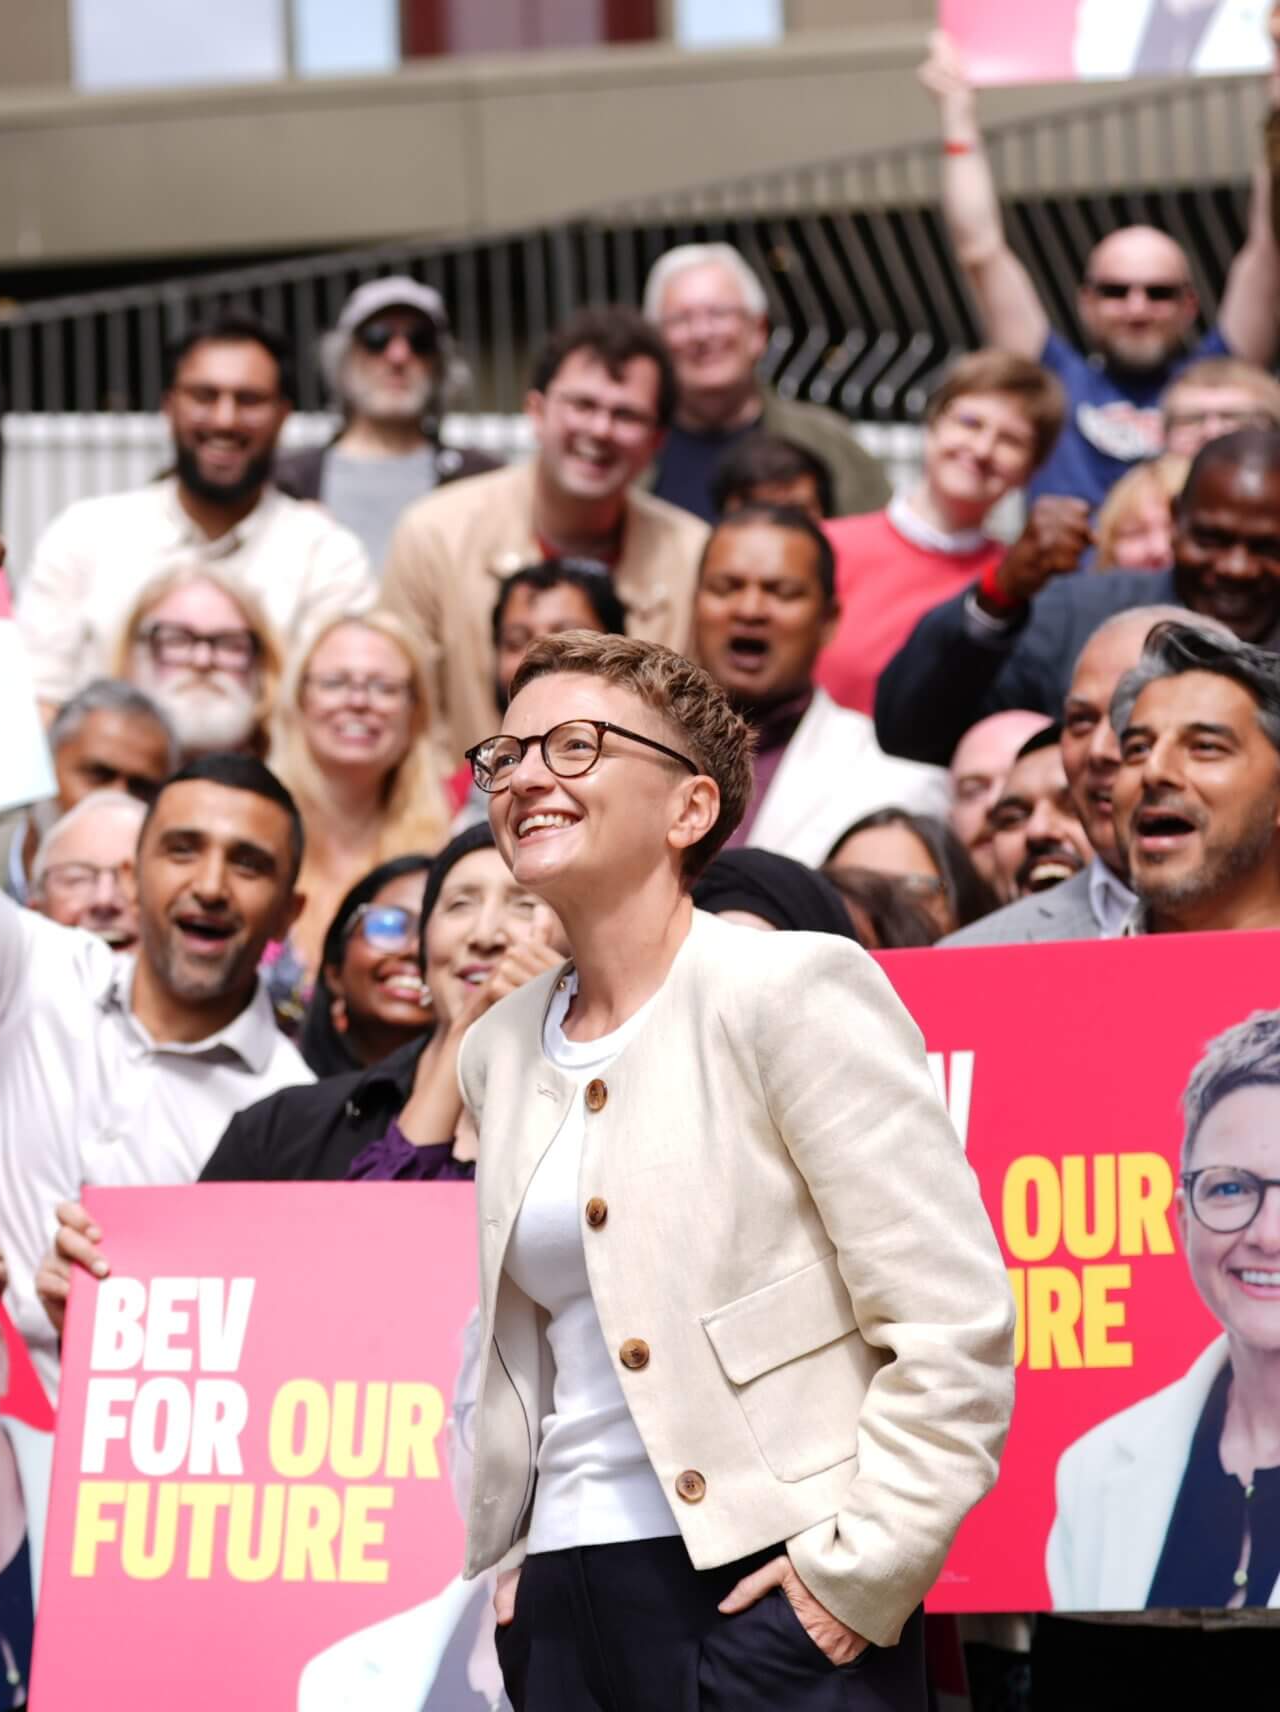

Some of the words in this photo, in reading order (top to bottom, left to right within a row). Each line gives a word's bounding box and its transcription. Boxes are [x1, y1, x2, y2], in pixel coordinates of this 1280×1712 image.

[1002, 1152, 1175, 1261] OUR
[90, 1276, 256, 1372] BEV
[80, 1376, 249, 1476] FOR
[268, 1379, 444, 1479] OUR
[71, 1481, 395, 1583] FUTURE
